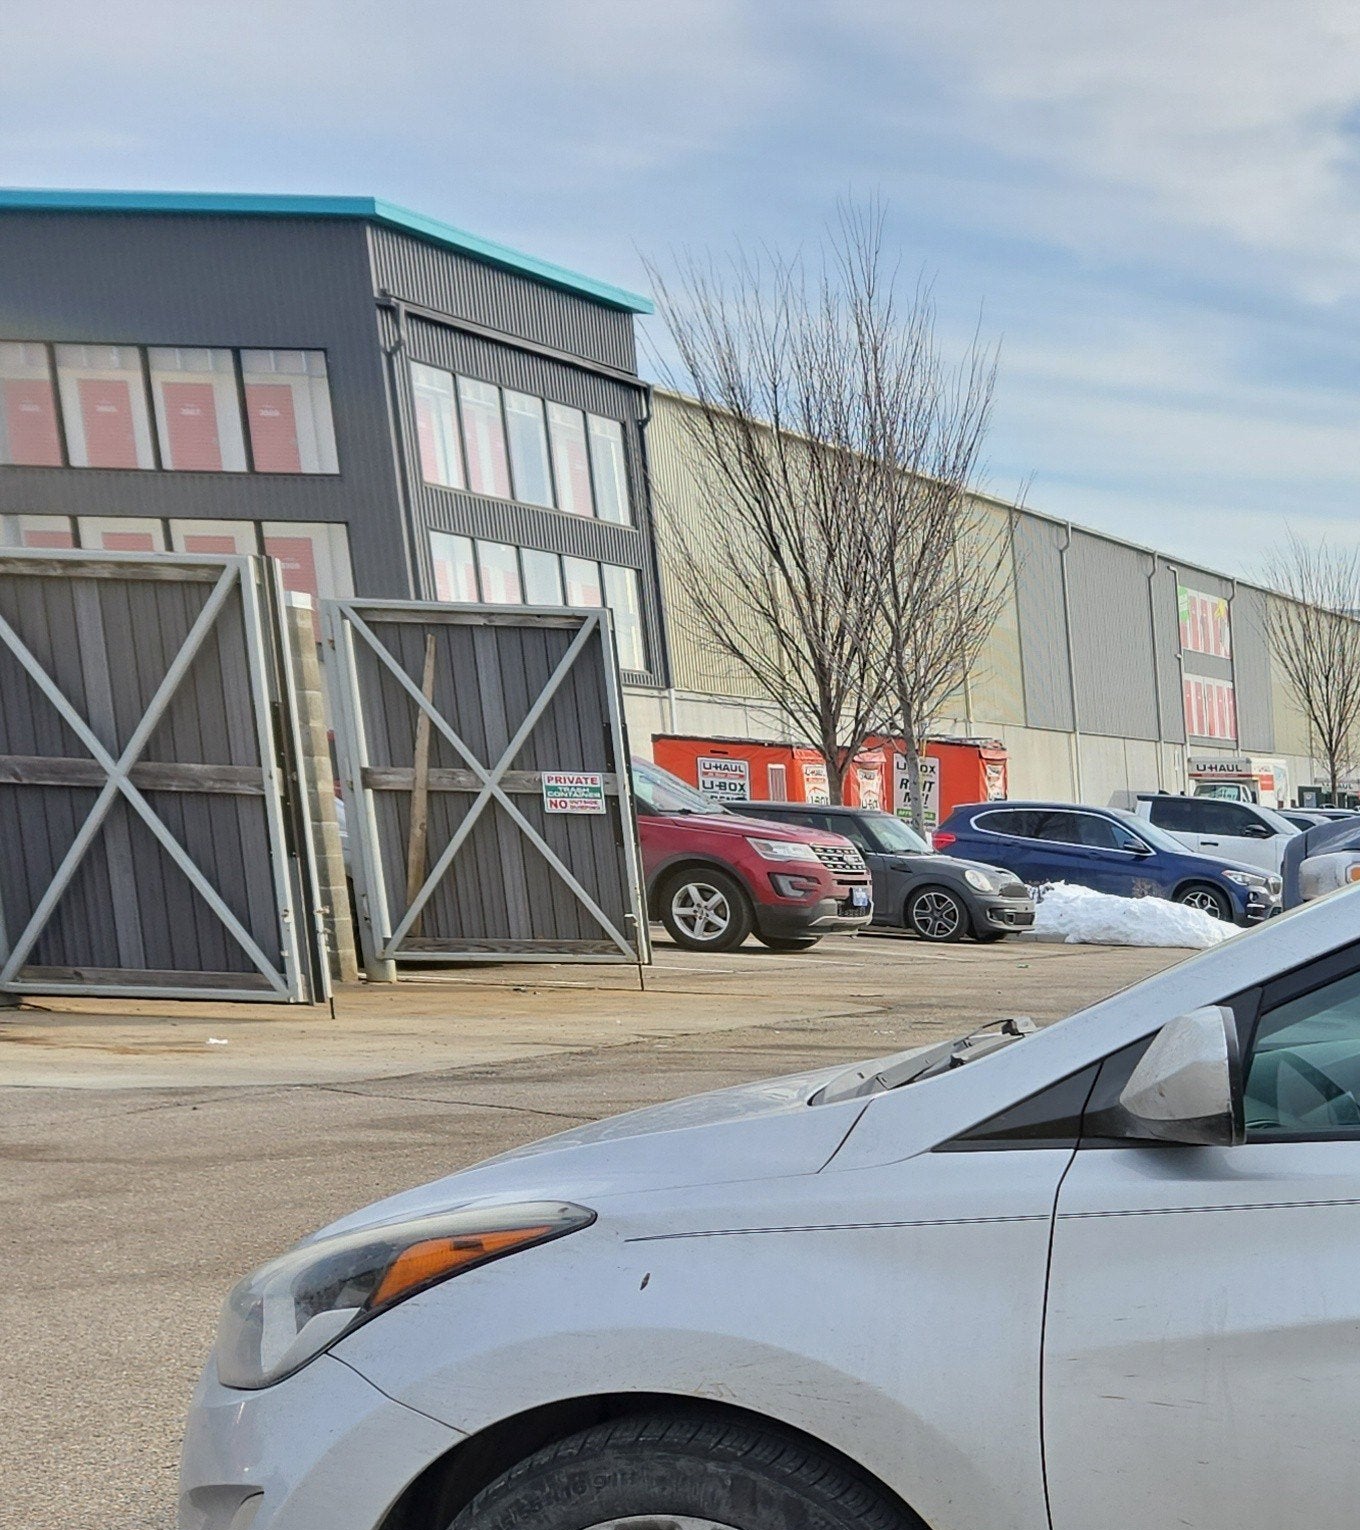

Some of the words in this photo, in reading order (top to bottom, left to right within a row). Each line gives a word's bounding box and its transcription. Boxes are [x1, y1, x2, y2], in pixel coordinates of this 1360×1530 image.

[702, 762, 744, 773] U-HAUL
[1196, 763, 1242, 772] U-HAUL
[546, 775, 599, 786] PRIVATE
[702, 780, 747, 793] U-BOX
[546, 790, 601, 798] CONTAINER
[549, 799, 568, 810] NO
